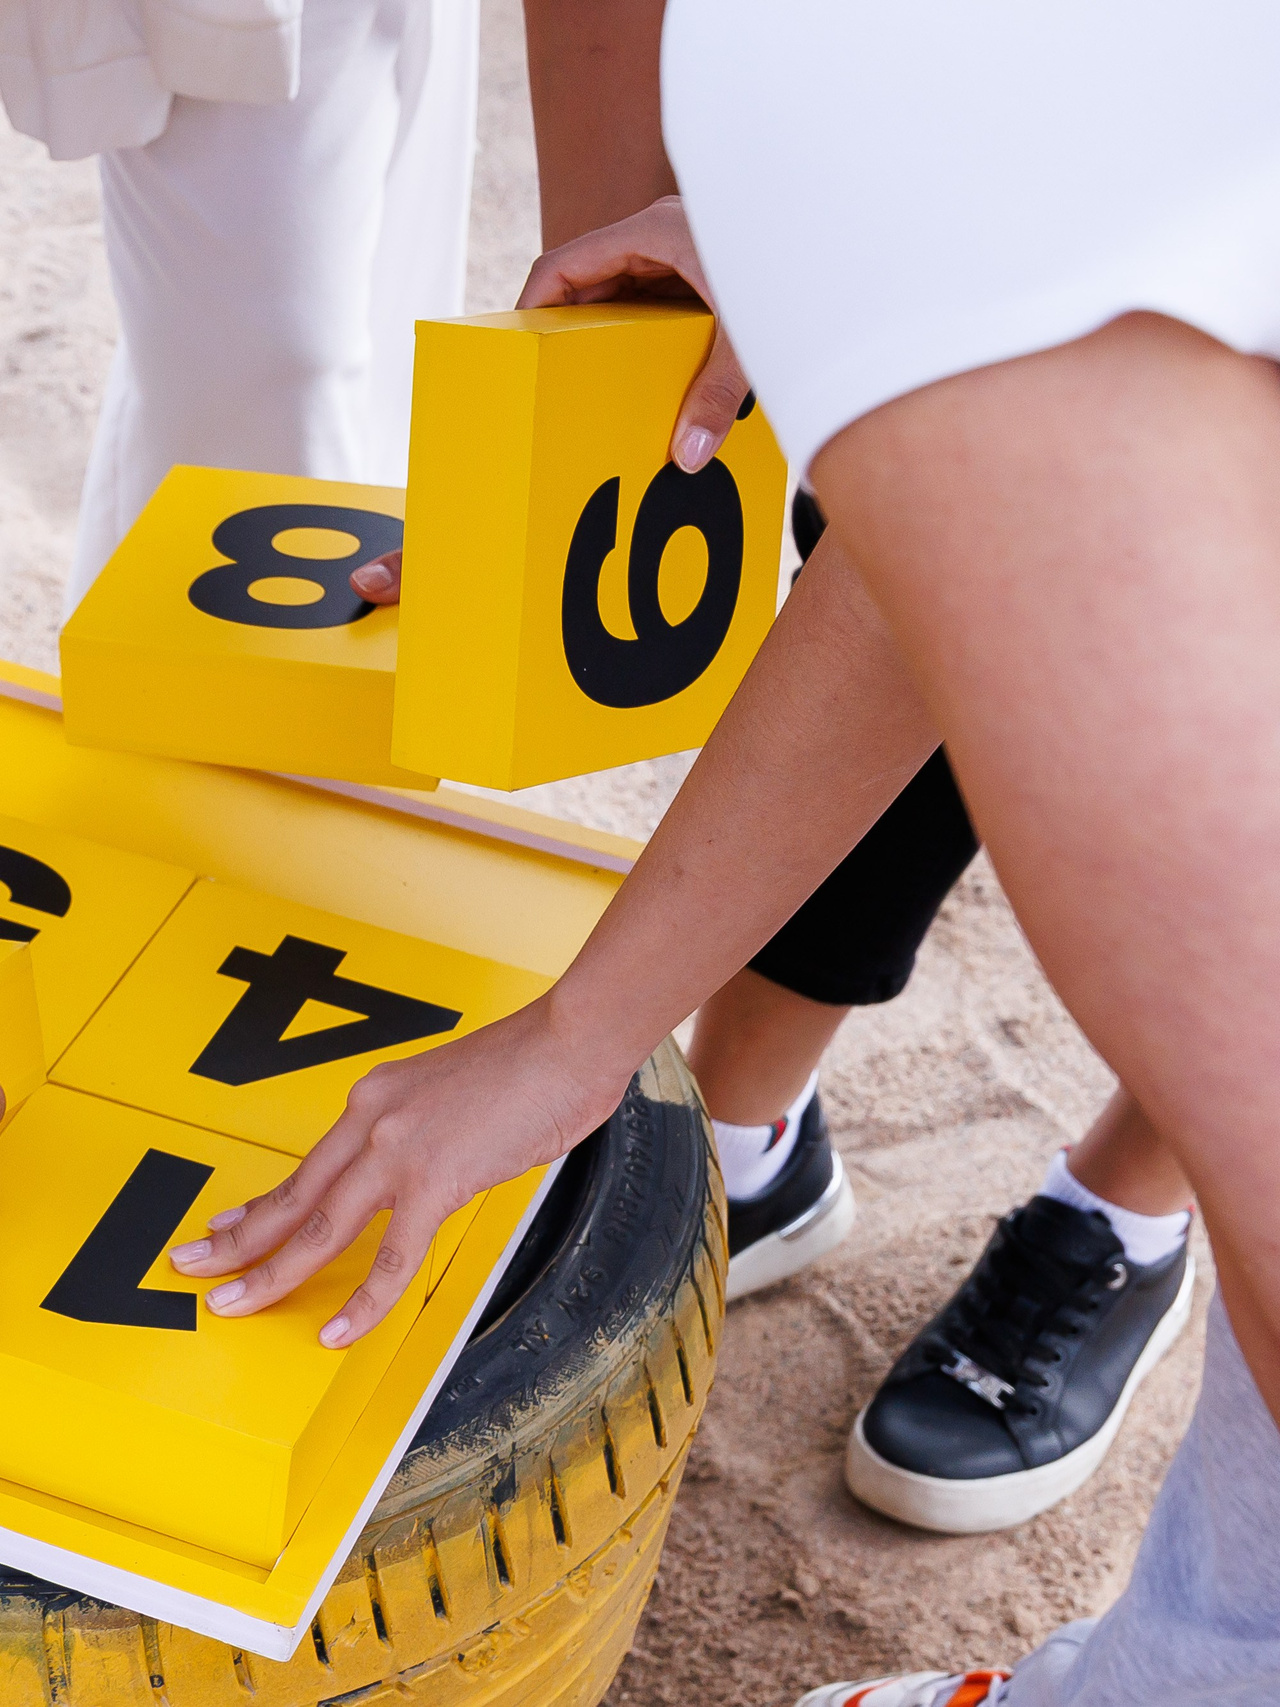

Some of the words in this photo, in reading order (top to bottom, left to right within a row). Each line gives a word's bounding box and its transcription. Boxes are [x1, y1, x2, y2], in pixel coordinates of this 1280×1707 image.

[188, 503, 405, 629] 8
[188, 934, 464, 1087] 4
[38, 1148, 216, 1332] 1
